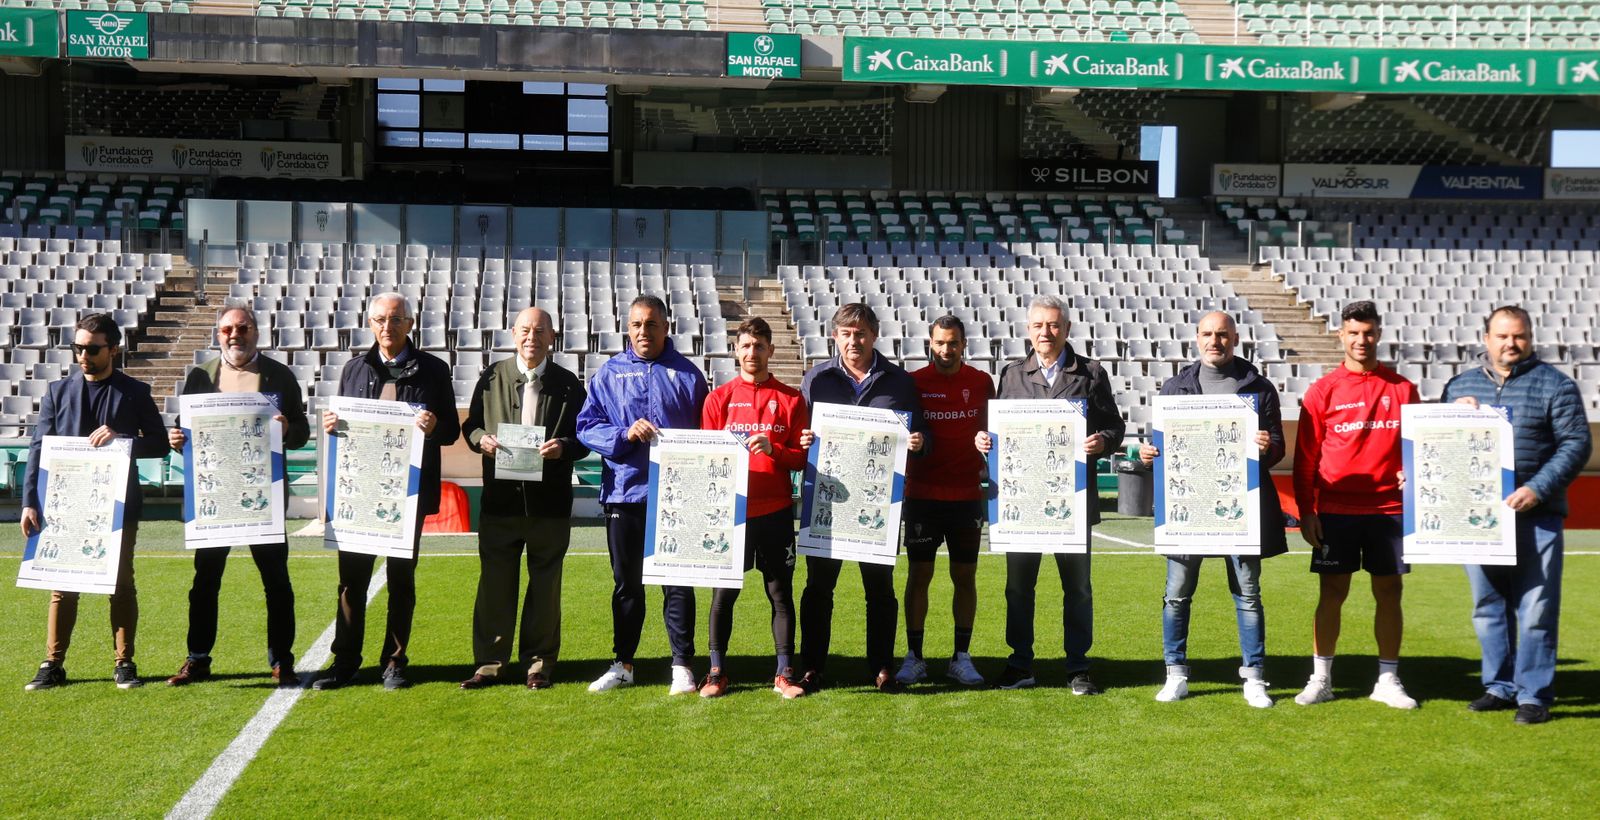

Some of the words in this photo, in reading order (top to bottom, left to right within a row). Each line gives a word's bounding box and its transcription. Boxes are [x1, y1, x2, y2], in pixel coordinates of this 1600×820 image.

[69, 34, 95, 45] SAN
[98, 35, 148, 47] RAFAEL
[86, 46, 133, 58] MOTOR
[728, 55, 752, 65] SAN
[754, 56, 798, 67] RAFAEL
[896, 51, 995, 73] CaixaBank
[1072, 55, 1170, 76] CaixaBank
[742, 66, 783, 77] MOTOR
[1247, 58, 1345, 80] CaixaBank
[1422, 61, 1522, 82] CaixaBank
[99, 145, 154, 156] Fundación
[188, 148, 242, 159] Fundación
[277, 151, 329, 161] Fundación
[99, 154, 140, 165] Córdoba
[141, 157, 154, 165] CF
[277, 160, 316, 169] Córdoba
[317, 161, 329, 169] CF
[1055, 167, 1149, 184] SILBON
[1312, 178, 1389, 189] VALMOPSUR
[1442, 176, 1524, 189] VALRENTAL
[923, 410, 966, 420] ÓRDOBA
[1385, 420, 1400, 429] CF
